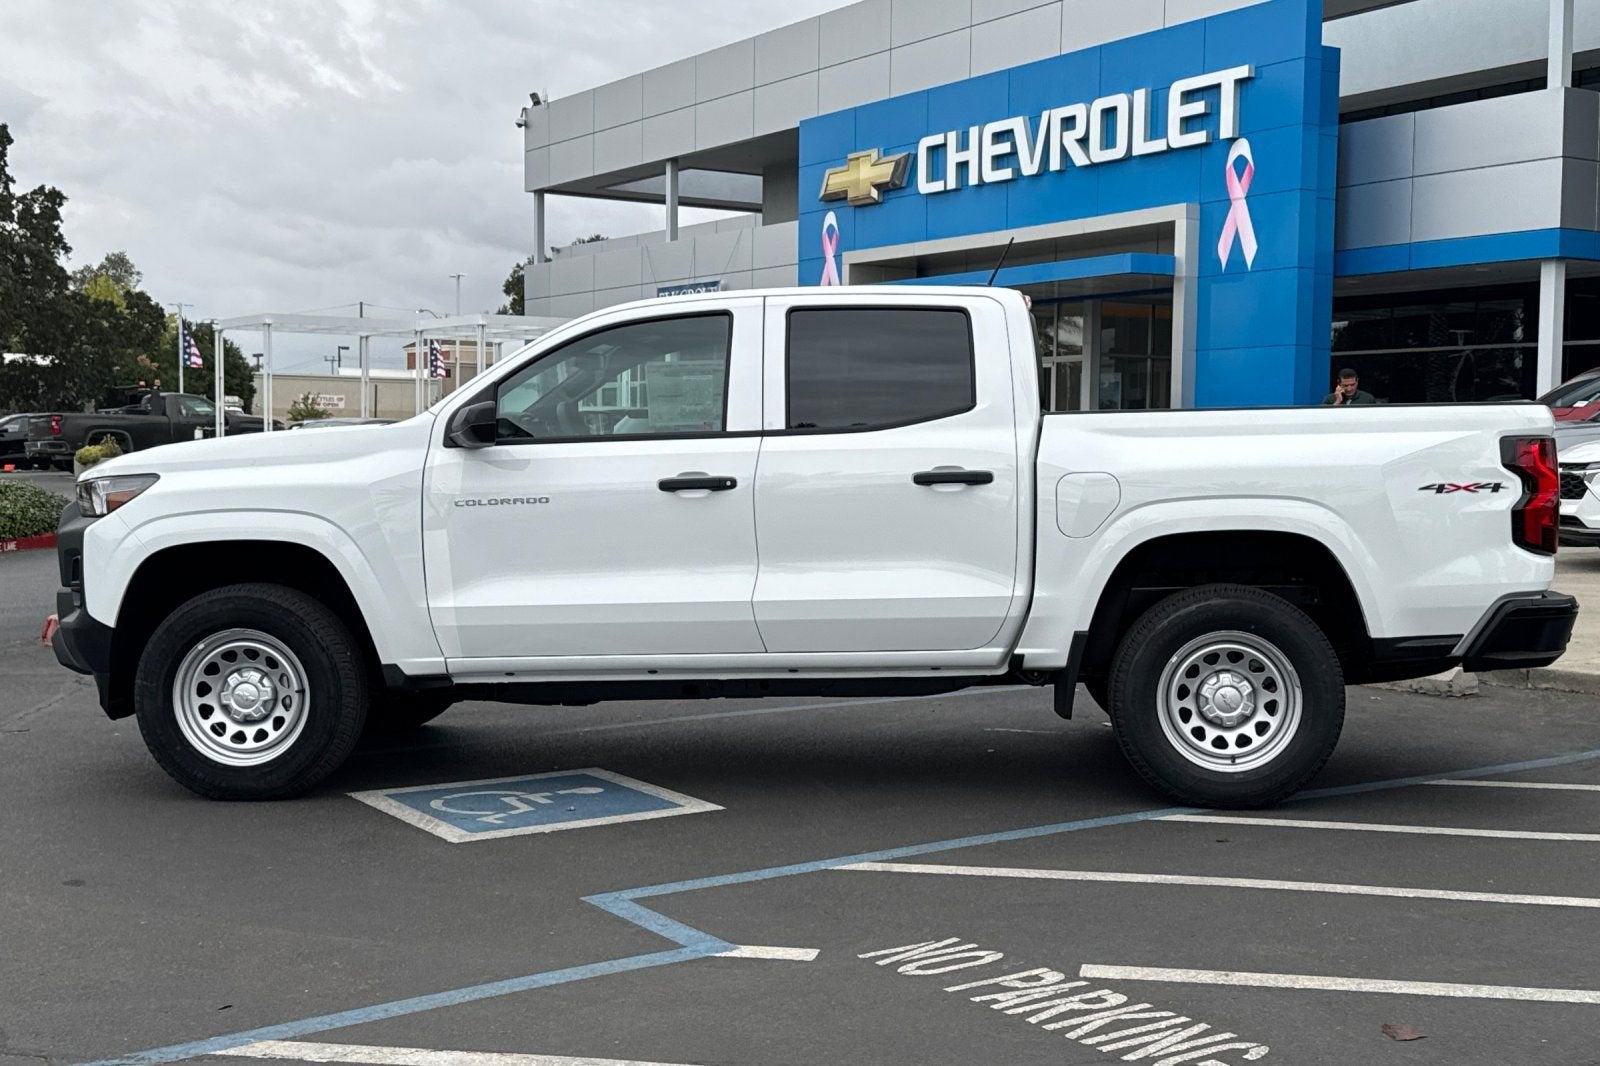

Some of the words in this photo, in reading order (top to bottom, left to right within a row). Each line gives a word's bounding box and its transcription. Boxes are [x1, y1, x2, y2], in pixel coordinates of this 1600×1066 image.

[917, 64, 1255, 195] CHEVROLET
[454, 496, 550, 507] COLORADO
[857, 936, 1004, 976] NO
[943, 967, 1269, 1066] PARKING
